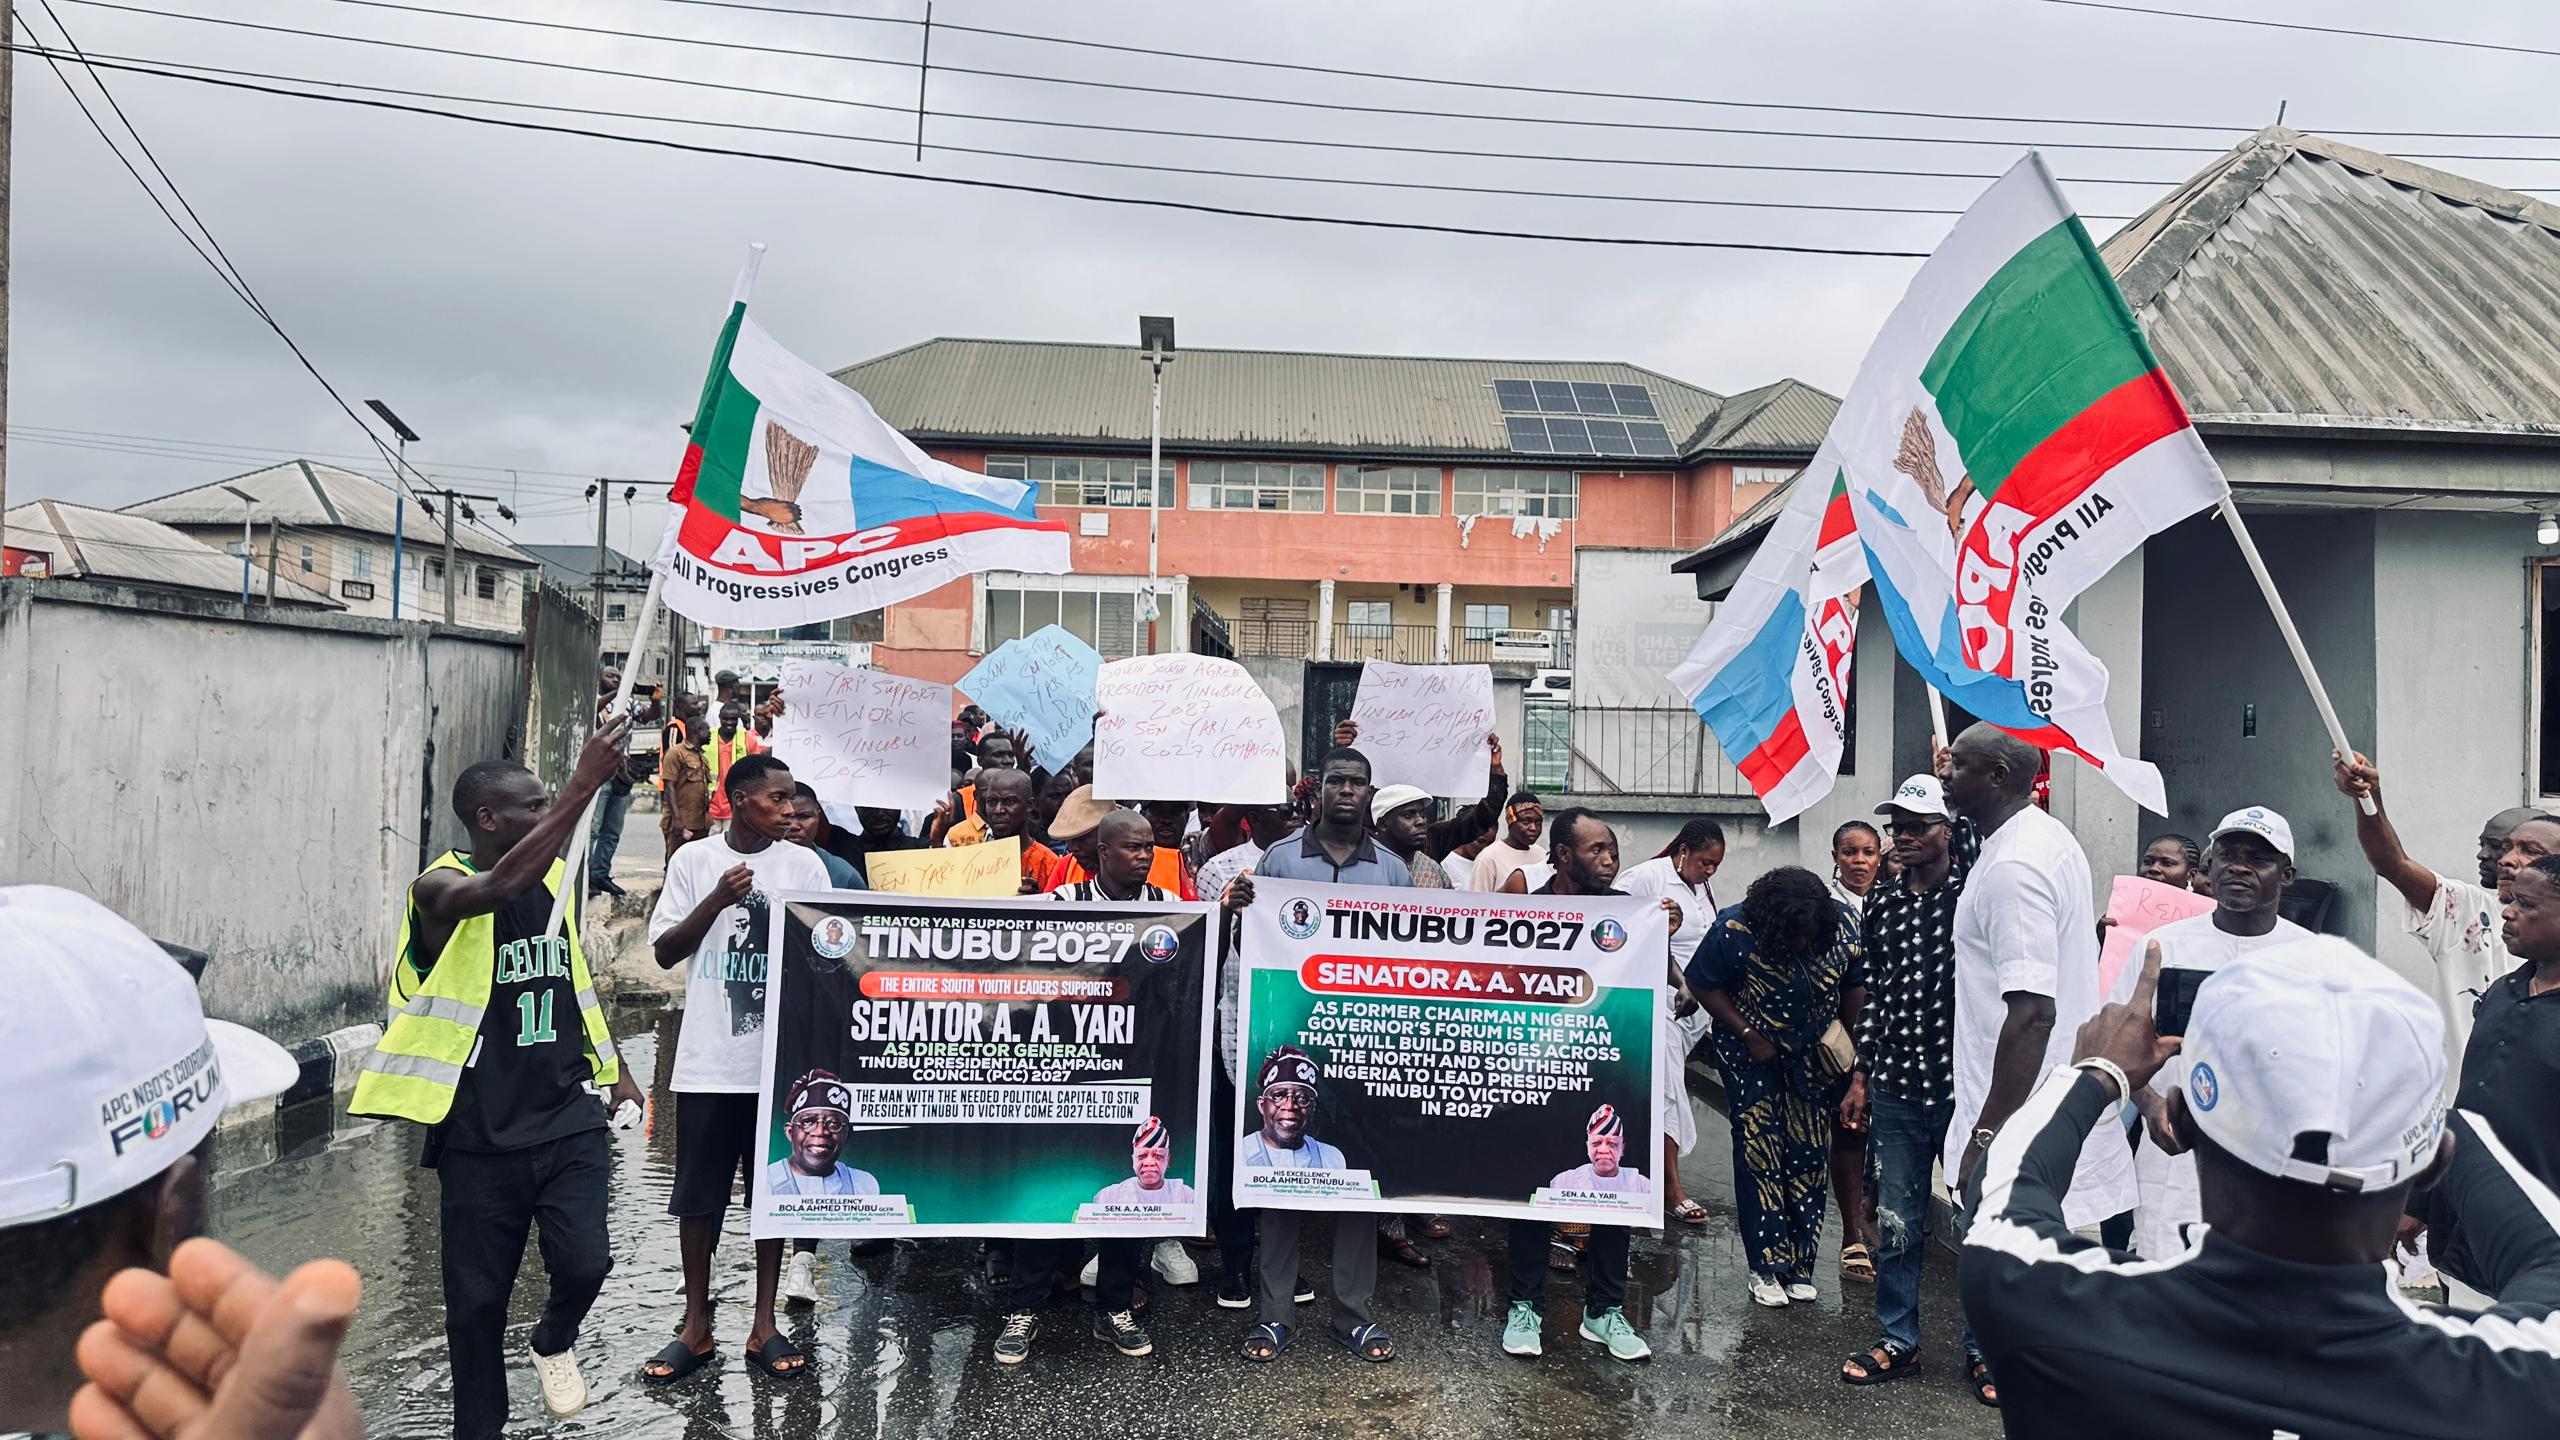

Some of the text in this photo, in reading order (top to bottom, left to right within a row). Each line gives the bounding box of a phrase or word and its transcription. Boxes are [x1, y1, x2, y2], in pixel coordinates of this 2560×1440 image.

[1111, 489, 1132, 504] LAW
[709, 526, 901, 571] APC
[673, 547, 948, 602] All Progressives Congress
[772, 645, 802, 654] GLOBAL
[1194, 662, 1242, 678] AGREE
[792, 700, 917, 726] NETWORK
[1150, 700, 1216, 721] 2027
[783, 729, 822, 748] FOR
[1135, 721, 1167, 736] SEN
[812, 755, 892, 781] 2027
[1327, 899, 1583, 922] SENATOR YARI SUPPORT NETWORK FOR
[862, 915, 1135, 933] SENATOR YARI SUPPORT NETWORK FOR
[1326, 909, 1475, 945] TINUBU
[1484, 918, 1584, 951] 2027
[861, 927, 1021, 961] TINUBU
[1031, 931, 1135, 963] 2027
[1601, 937, 1617, 946] APC
[880, 977, 1113, 997] THE ENTIRE SOUTH YOUTH LEADERS SUPPORTS
[1318, 962, 1583, 997] SENATOR A. A. YARI
[517, 989, 556, 1047] 11
[851, 1000, 1135, 1044] SENATOR A. A. YARI
[1311, 1001, 1609, 1029] AS FORMER CHAIRMAN NIGERIA
[1307, 1016, 1612, 1045] GOVERNOR'S FORUM IS THE MAN
[883, 1042, 1101, 1058] AS DIRECTOR GENERAL
[1297, 1031, 1621, 1062] THAT WILL BUILD BRIDGES ACROSS
[859, 1056, 1123, 1071] TINUBU PRESIDENTIAL CAMPAIGN
[1329, 1048, 1588, 1075] THE NORTH AND SOUTHERN
[912, 1069, 1071, 1083] COUNCIL (PCC) 2027
[1323, 1064, 1593, 1092] NIGERIA TO LEAD PRESIDENT
[102, 1069, 174, 1125] APC NGO'S
[856, 1089, 1139, 1105] THE MAN WITH THE NEEDED POLITICAL CAPITAL TO STIR
[1364, 1082, 1552, 1106] TINUBU TO VICTORY
[861, 1104, 1133, 1119] PRESIDENT TINUBU TO VICTORY COME 2027 ELECTION
[1421, 1101, 1493, 1119] IN 2027
[2403, 1125, 2420, 1148] APC
